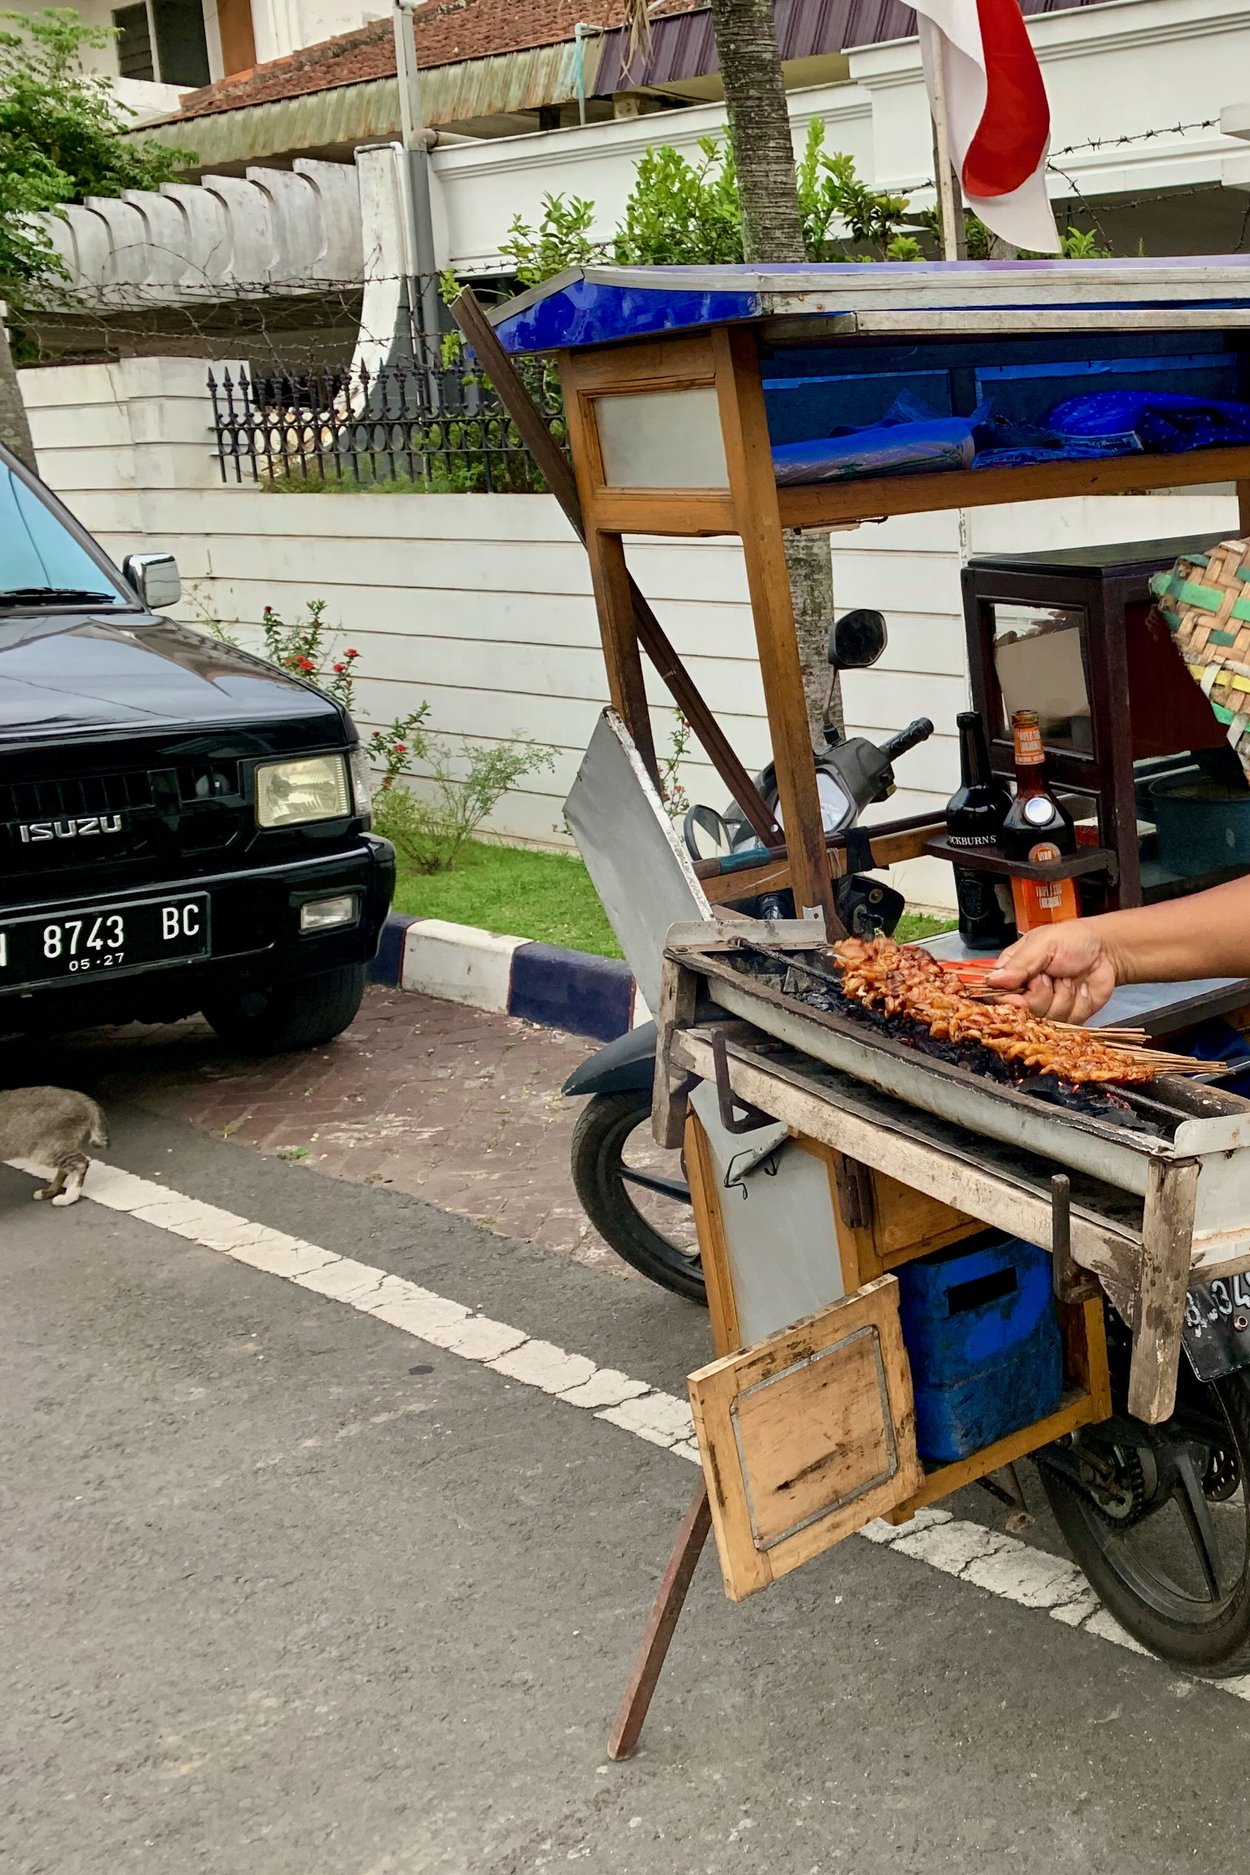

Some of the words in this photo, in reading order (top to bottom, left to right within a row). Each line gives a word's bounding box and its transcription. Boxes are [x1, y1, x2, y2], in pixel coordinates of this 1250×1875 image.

[20, 814, 122, 842] ISUZU
[43, 915, 124, 958] 8743
[162, 904, 200, 940] BC
